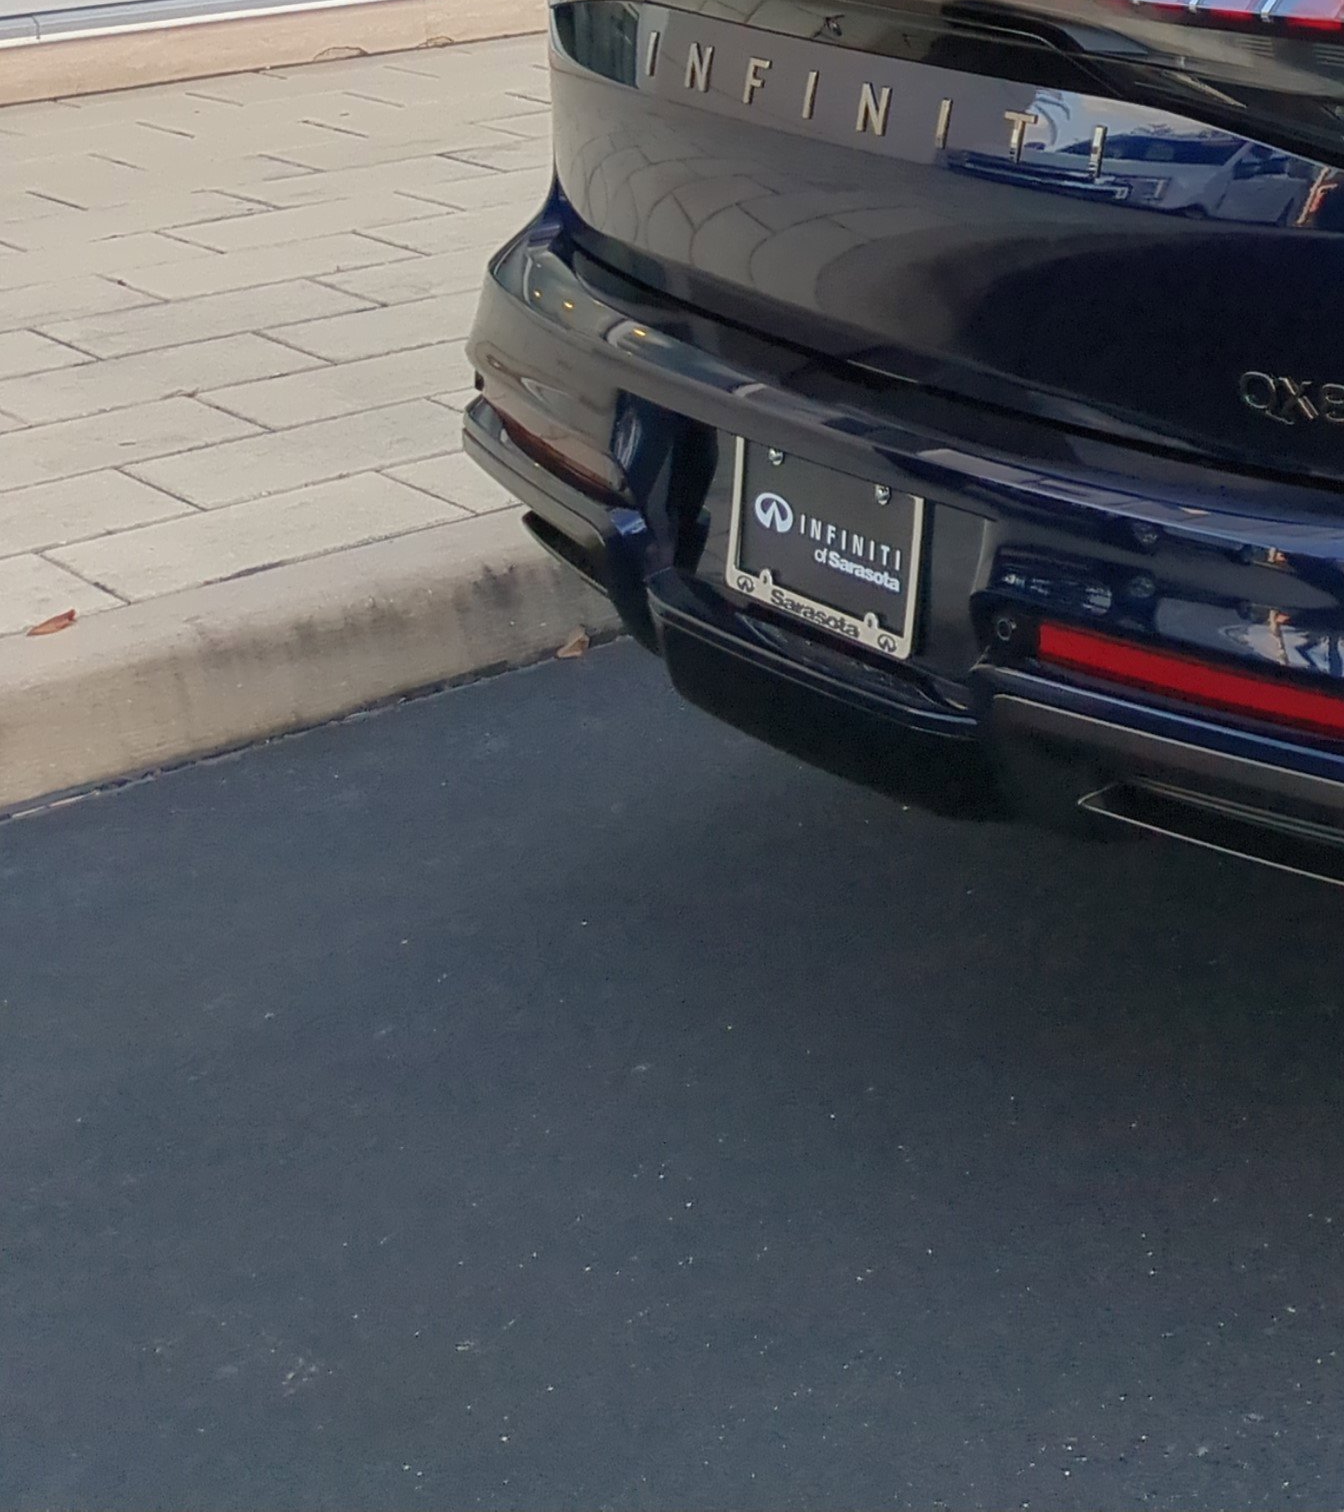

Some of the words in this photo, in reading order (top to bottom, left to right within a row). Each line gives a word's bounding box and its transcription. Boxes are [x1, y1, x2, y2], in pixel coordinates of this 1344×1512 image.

[644, 30, 1109, 184] INFINITI
[800, 513, 901, 572] INFINITI
[828, 552, 901, 593] Sarasota
[770, 588, 860, 639] Sarasota
